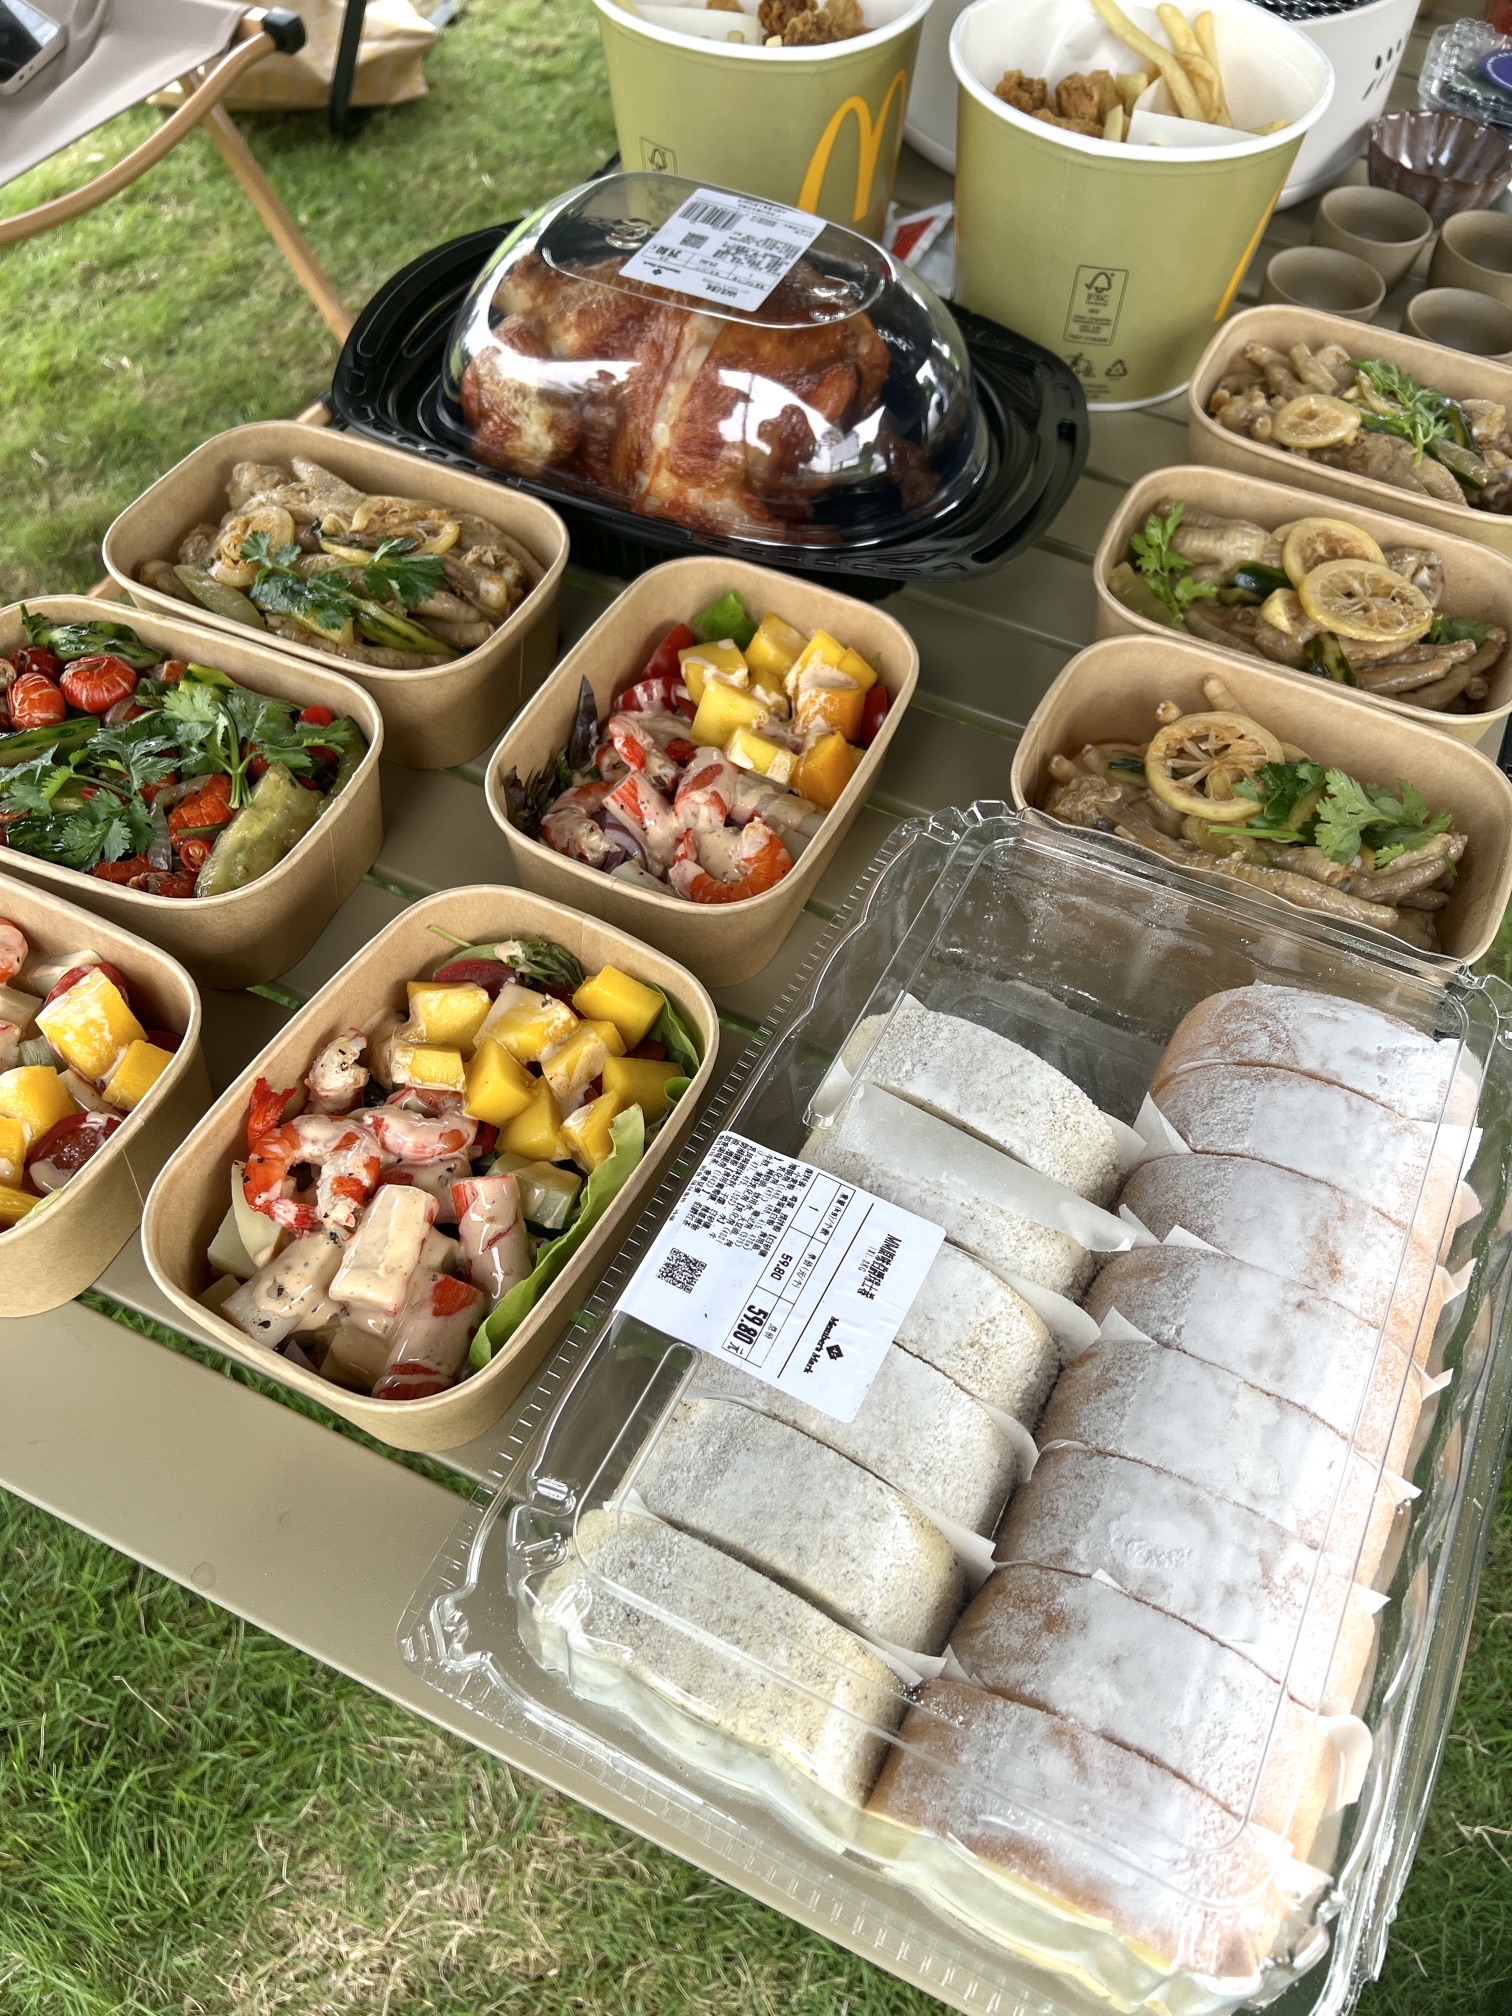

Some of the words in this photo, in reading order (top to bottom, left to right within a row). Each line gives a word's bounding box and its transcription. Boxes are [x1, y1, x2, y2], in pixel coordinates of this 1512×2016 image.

[770, 1253, 793, 1280] 59.80
[732, 1304, 769, 1345] 59.80
[814, 1315, 839, 1352] Member's
[726, 1341, 743, 1354] 元
[802, 1351, 820, 1373] Mark
